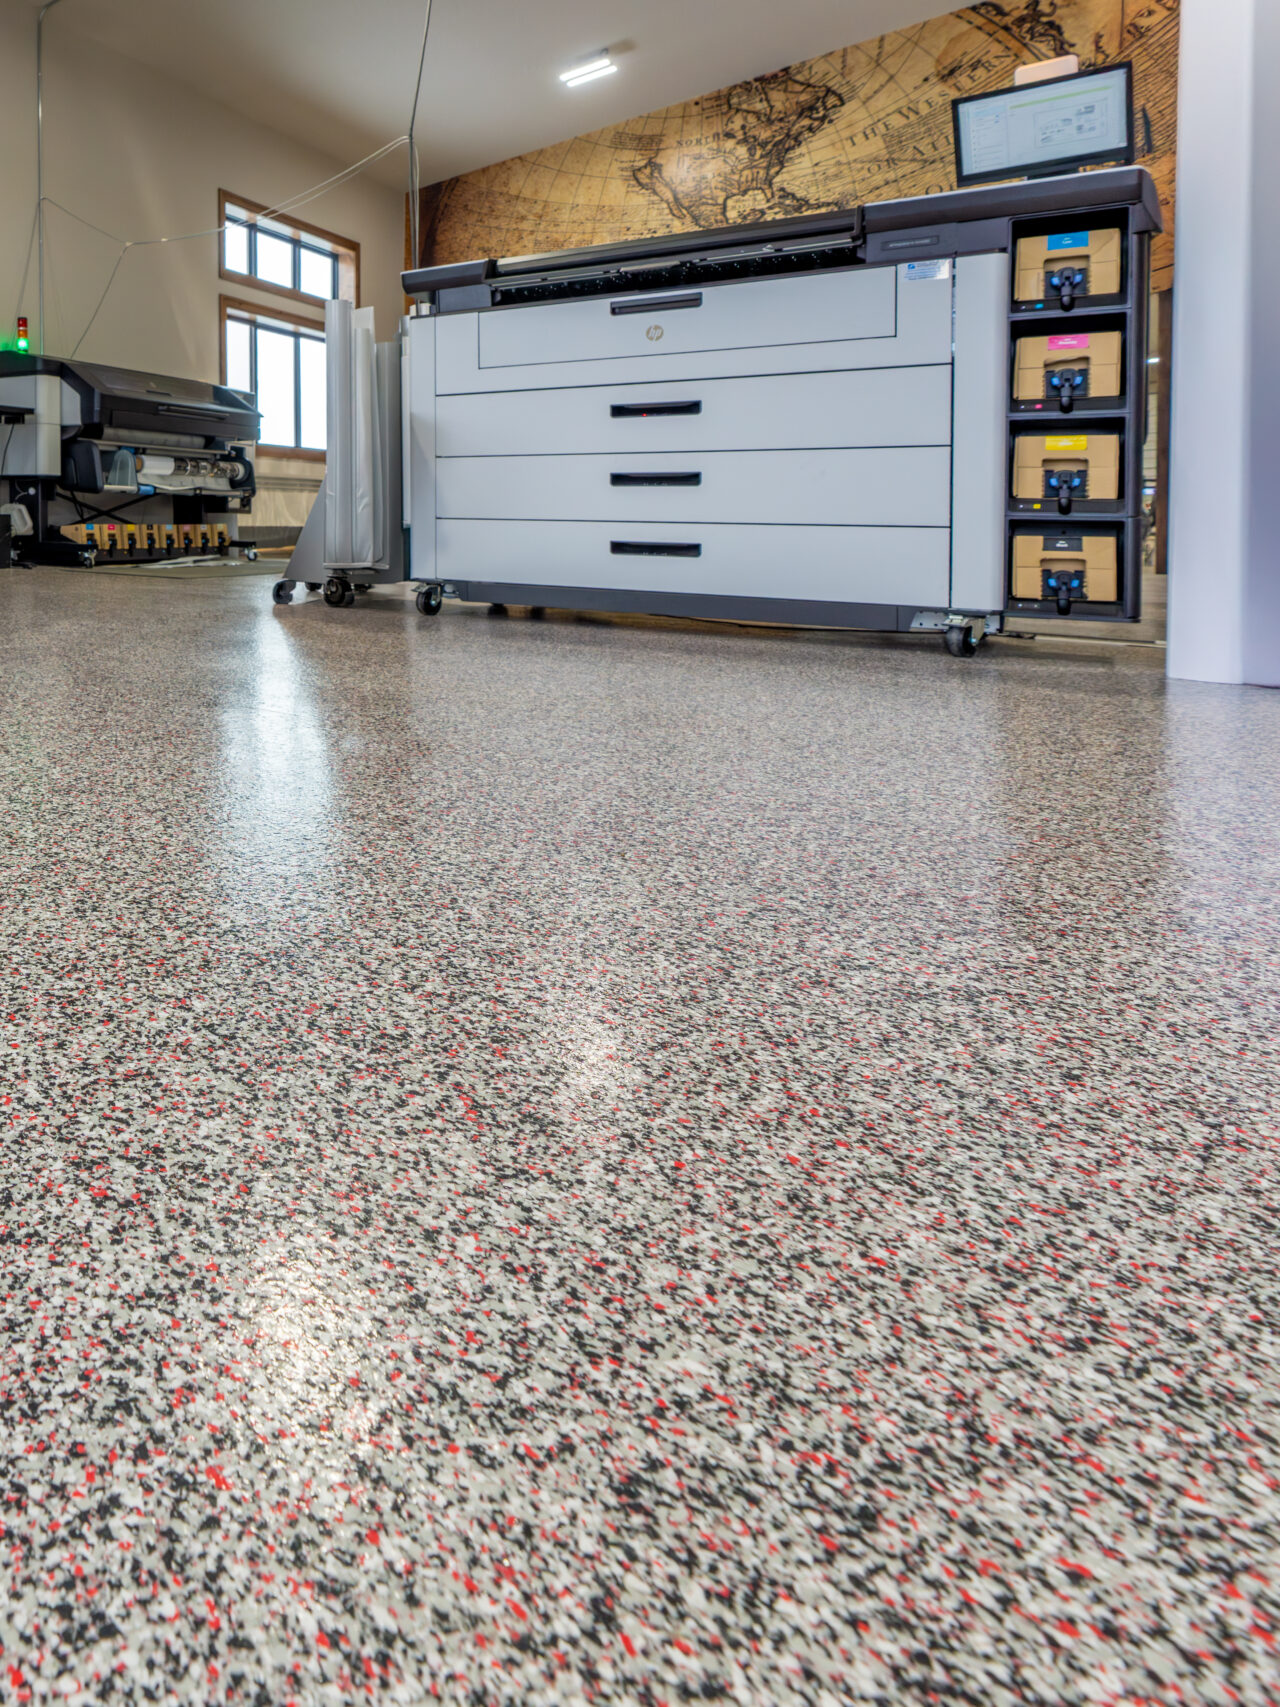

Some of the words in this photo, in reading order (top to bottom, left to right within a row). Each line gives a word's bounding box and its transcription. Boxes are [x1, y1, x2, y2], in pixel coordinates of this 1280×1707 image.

[847, 120, 895, 147] THE
[896, 52, 1020, 121] WESTERN
[646, 324, 664, 342] hp
